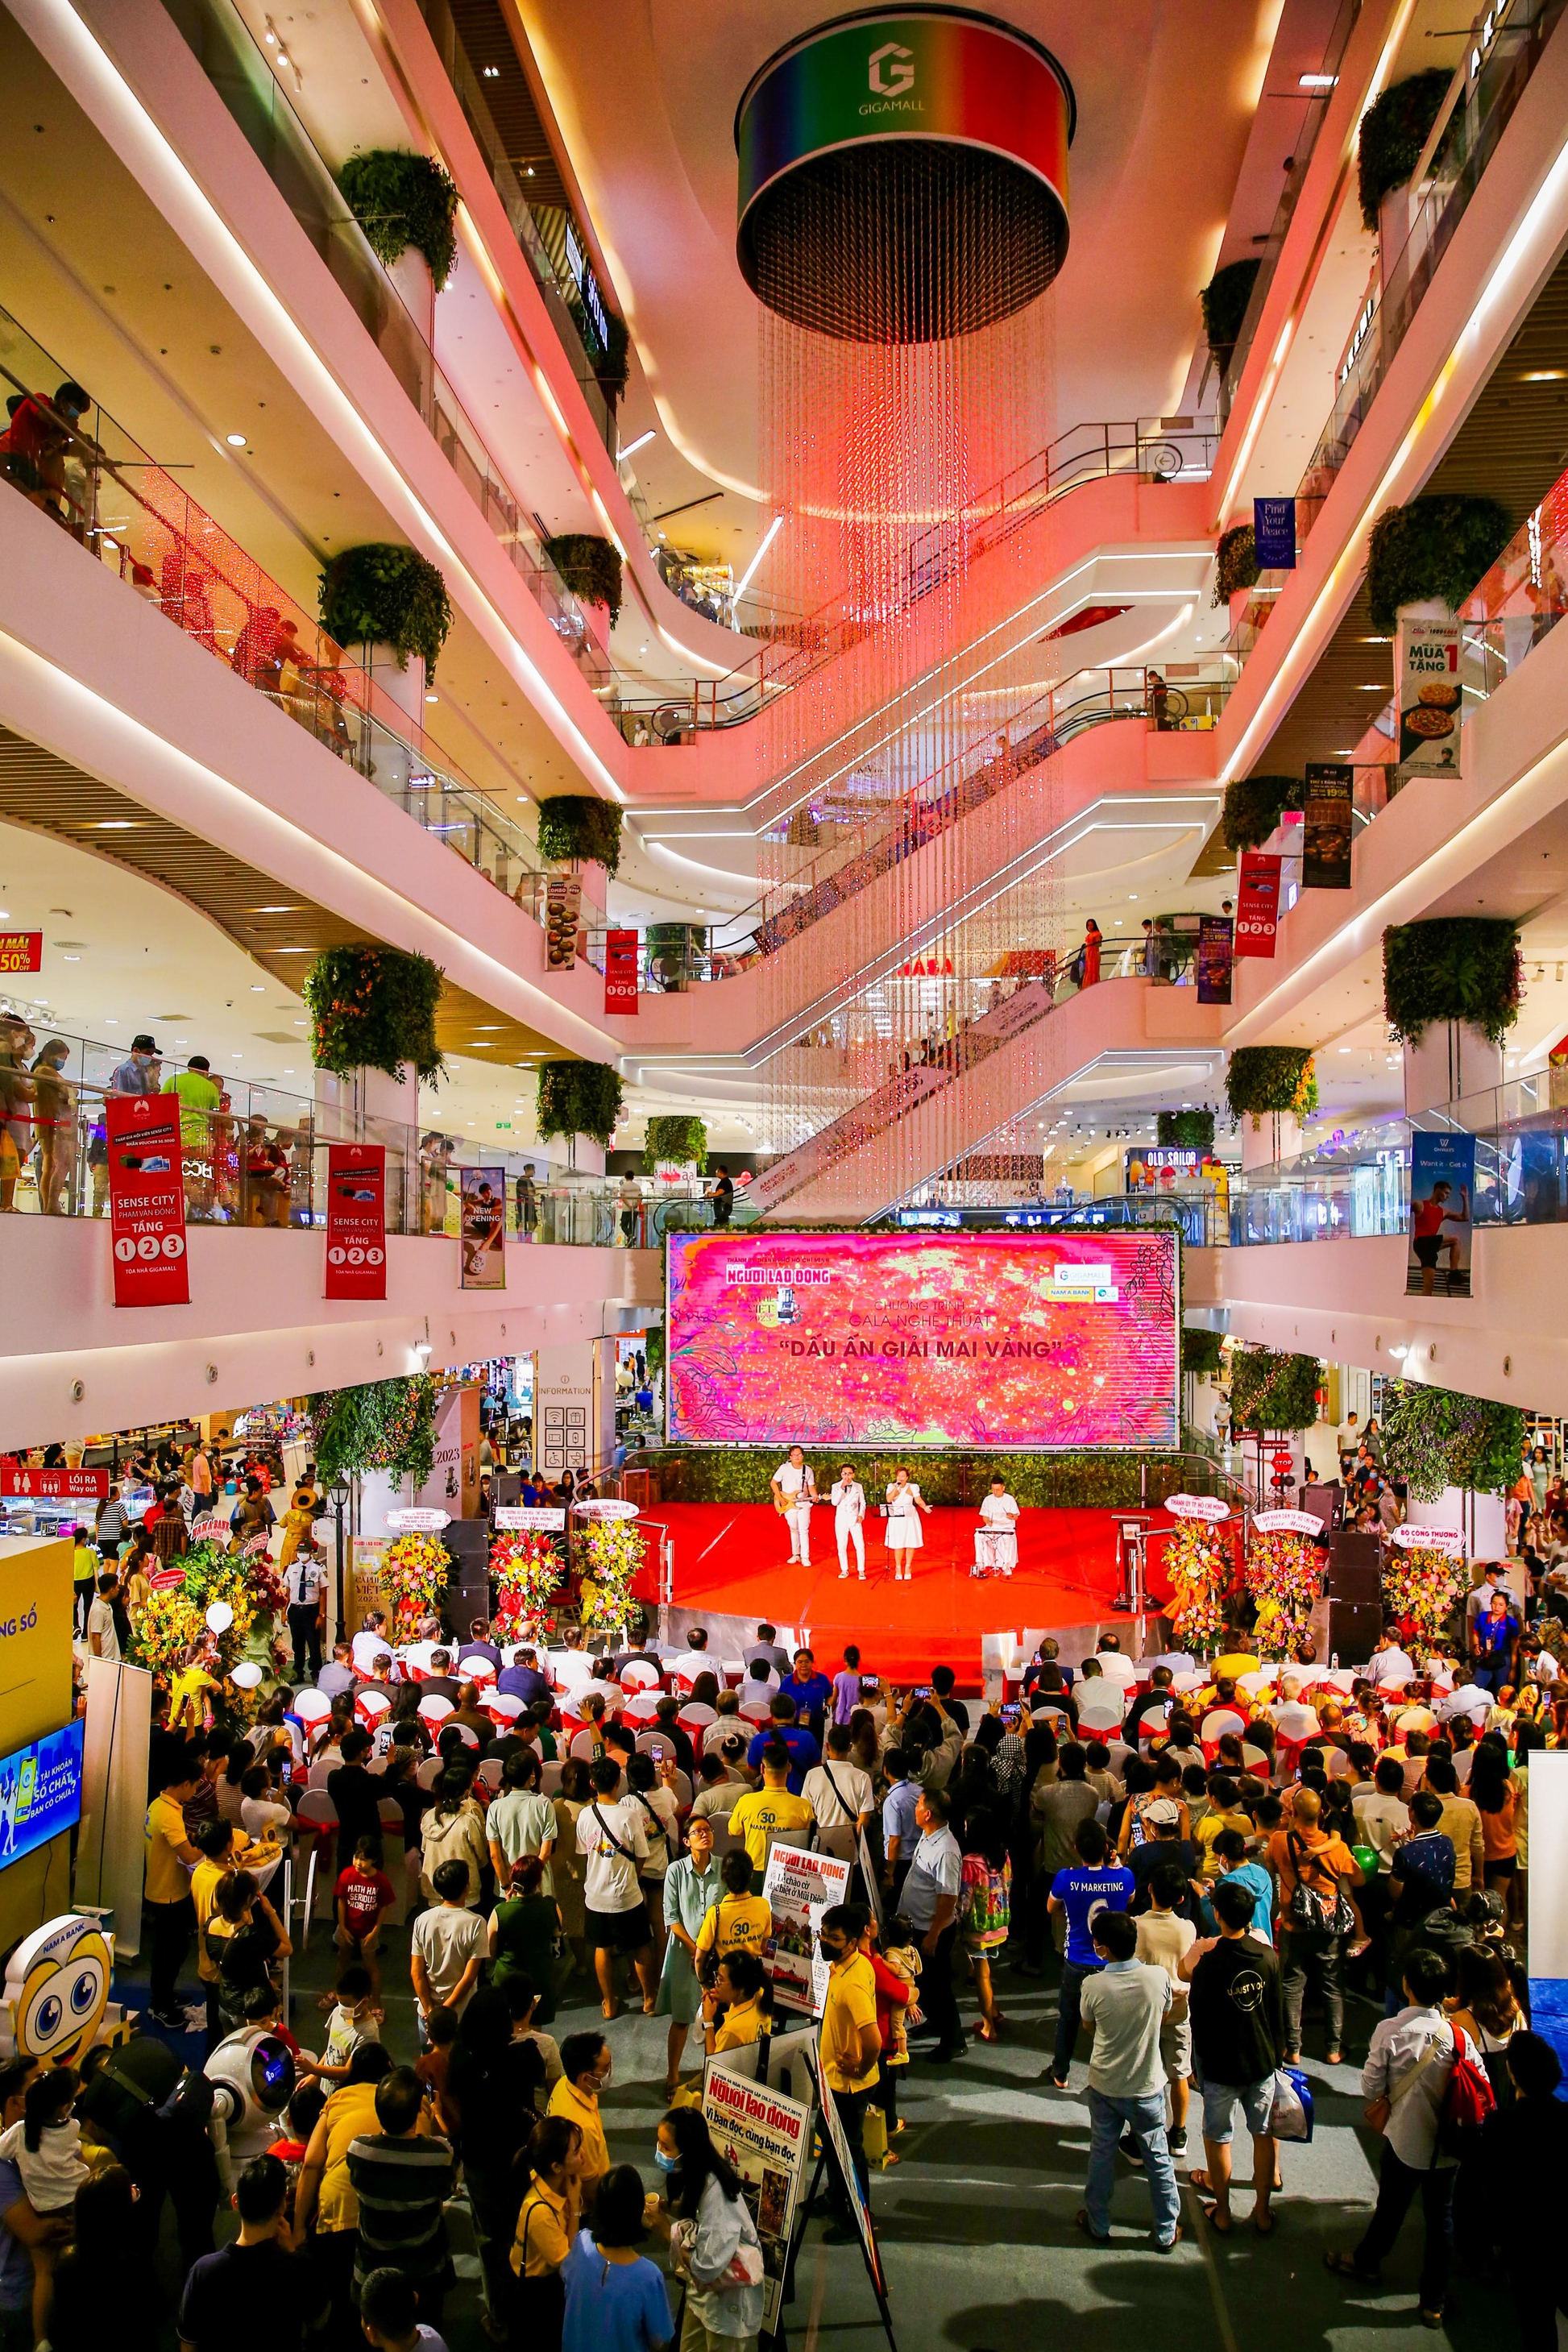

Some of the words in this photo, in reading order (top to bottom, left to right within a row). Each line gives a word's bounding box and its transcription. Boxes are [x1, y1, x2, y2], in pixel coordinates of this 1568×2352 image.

[859, 100, 925, 116] GIGAMALL
[1265, 504, 1285, 514] Find
[1264, 516, 1285, 525] Your
[1263, 525, 1288, 536] Peace
[1409, 645, 1445, 659] MUA
[1444, 645, 1458, 672] 1
[1409, 658, 1446, 674] TẶNG
[1253, 923, 1259, 931] 2
[1267, 923, 1272, 932] 3
[5, 935, 30, 949] MÃI
[1147, 1151, 1164, 1167] OLD
[1167, 1151, 1197, 1166] SAILOR
[118, 1197, 150, 1209] SENSE
[151, 1194, 176, 1206] CITY
[334, 1217, 359, 1226] SENSE
[361, 1218, 379, 1226] CITY
[465, 1214, 500, 1222] OPENING
[121, 1242, 128, 1256] 1
[143, 1239, 154, 1255] 2
[168, 1238, 178, 1253] 3
[334, 1250, 340, 1261] 1
[352, 1250, 360, 1261] 2
[371, 1250, 379, 1261] 3
[149, 1265, 176, 1273] GIGAMALL
[728, 1268, 765, 1284] NGƯỜI
[769, 1269, 794, 1284] LAO
[795, 1269, 829, 1284] ĐỘNG
[873, 1300, 930, 1311] CHƯƠNG
[931, 1299, 965, 1311] TRÌNH
[749, 1314, 772, 1322] 2023
[848, 1315, 890, 1327] GALA
[896, 1312, 940, 1329] NGHỆ
[944, 1312, 992, 1329] THUẬT
[843, 1334, 874, 1357] ẤN
[881, 1334, 928, 1358] GIẢI
[936, 1341, 977, 1358] MAI
[985, 1336, 1062, 1359] VÀNG”
[538, 1387, 591, 1396] INFORMATION
[69, 1473, 83, 1484] LỐI
[85, 1475, 97, 1484] RA
[69, 1485, 84, 1493] Way
[1213, 1503, 1225, 1511] MINH
[193, 1522, 209, 1538] NAM
[214, 1520, 230, 1531] BANK
[1400, 1529, 1410, 1537] BỘ
[1411, 1529, 1430, 1537] CÔNG
[1406, 1537, 1425, 1545] Chúc
[355, 1584, 381, 1597] VIỆT
[19, 1602, 37, 1632] SỐ
[40, 1769, 51, 1782] TÀI
[51, 1757, 73, 1776] KHOẢN
[34, 1781, 48, 1804] SỐ
[48, 1769, 73, 1794] CHẤT
[31, 1804, 44, 1819] BẠN
[44, 1797, 54, 1810] CÓ
[760, 1812, 776, 1824] 30
[750, 1823, 766, 1831] NAM
[773, 1848, 800, 1868] NGƯỜI
[801, 1856, 819, 1873] LAO
[820, 1862, 846, 1880] ĐỘNG
[347, 1884, 366, 1894] MATH
[786, 1876, 801, 1888] chào
[801, 1880, 811, 1890] cờ
[1070, 1881, 1080, 1891] SV
[1081, 1881, 1124, 1892] MARKETING
[350, 1893, 377, 1903] SERIOUS
[767, 1881, 778, 1892] đặc
[778, 1883, 791, 1897] biệt
[791, 1887, 797, 1897] ở
[797, 1889, 810, 1902] Mũi
[810, 1893, 824, 1906] Điện
[734, 1922, 750, 1936] 30
[43, 1937, 60, 1954] NAM
[60, 1935, 65, 1943] A
[65, 1923, 85, 1939] BANK
[722, 1938, 741, 1946] NAM
[1250, 1981, 1266, 1991] YOU
[732, 2080, 741, 2089] NĂM
[741, 2084, 754, 2094] THÀNH
[709, 2076, 746, 2111] Người
[745, 2093, 766, 2121] lao
[766, 2105, 801, 2140] động
[706, 2105, 714, 2121] Vì
[713, 2109, 728, 2129] bạn
[728, 2118, 745, 2138] đọc,
[745, 2127, 765, 2149] cùng
[765, 2135, 781, 2155] bạn
[781, 2145, 796, 2164] đọc
